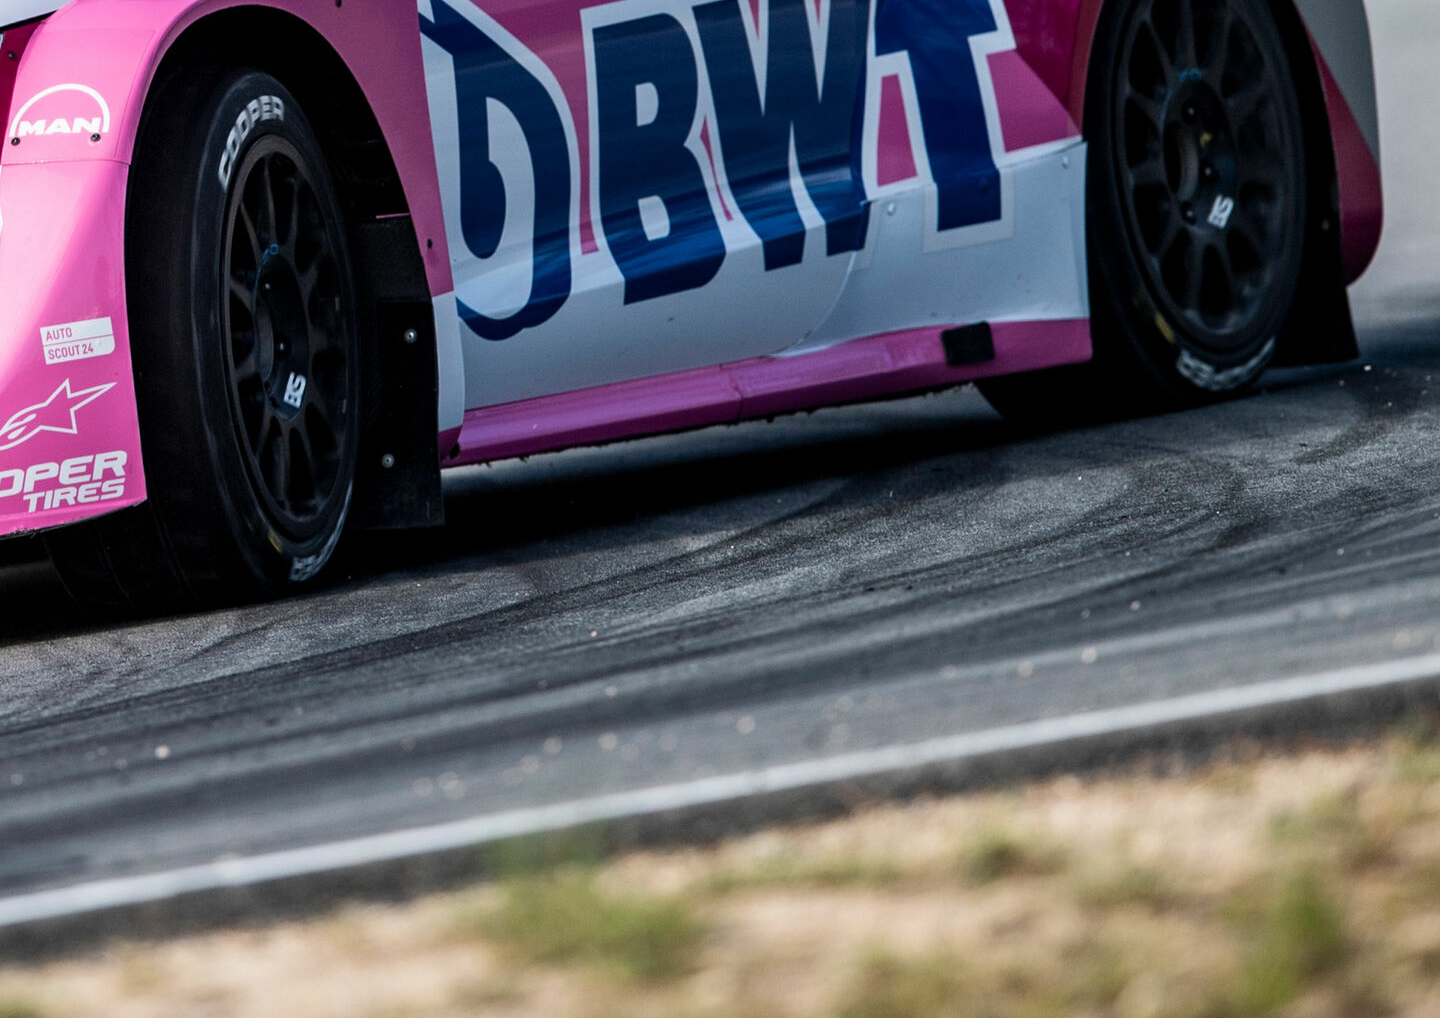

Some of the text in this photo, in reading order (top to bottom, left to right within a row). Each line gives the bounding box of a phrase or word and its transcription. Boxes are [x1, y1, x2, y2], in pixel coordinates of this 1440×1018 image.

[18, 117, 102, 137] MAN
[218, 94, 284, 191] COOPER
[46, 327, 72, 342] AUTO
[23, 477, 126, 513] TIRES
